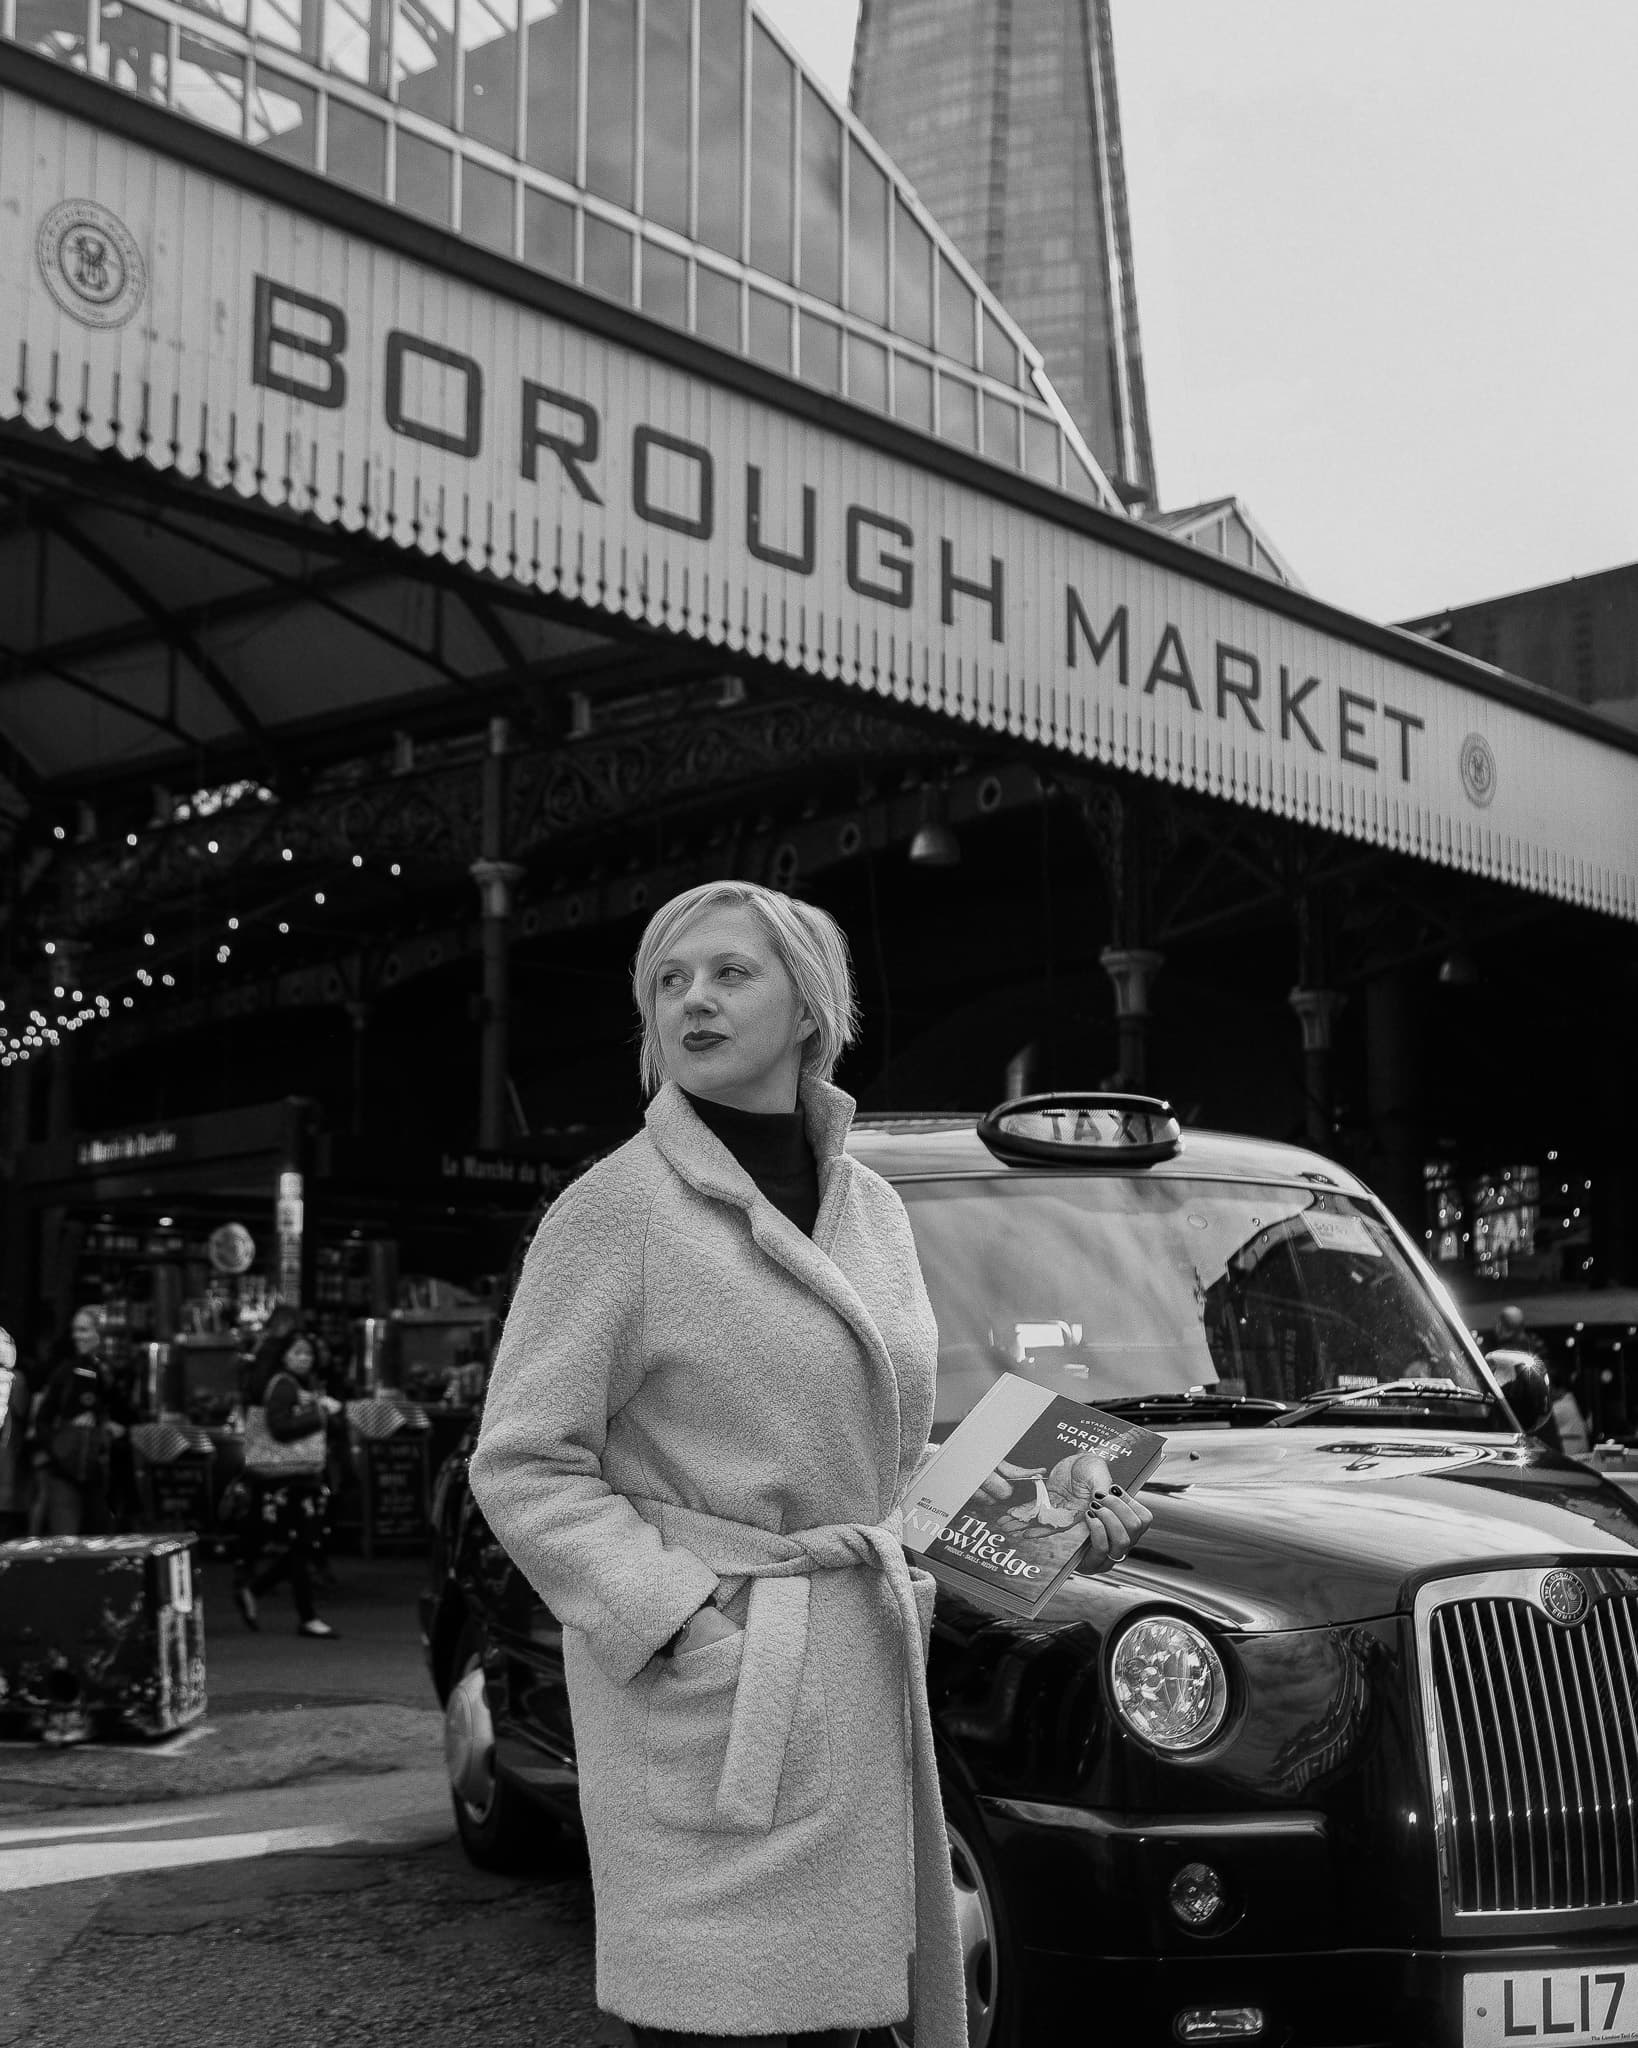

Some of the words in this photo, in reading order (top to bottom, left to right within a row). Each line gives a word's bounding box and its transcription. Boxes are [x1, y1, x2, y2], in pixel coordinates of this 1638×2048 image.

[252, 271, 1003, 643] BOROUGH
[1065, 583, 1426, 783] MARKET
[1043, 1110, 1154, 1143] TAXI
[1056, 1422, 1133, 1457] BOROUGH
[1056, 1433, 1119, 1462] MARKET
[903, 1506, 1041, 1579] Knowledge
[958, 1515, 1006, 1548] The
